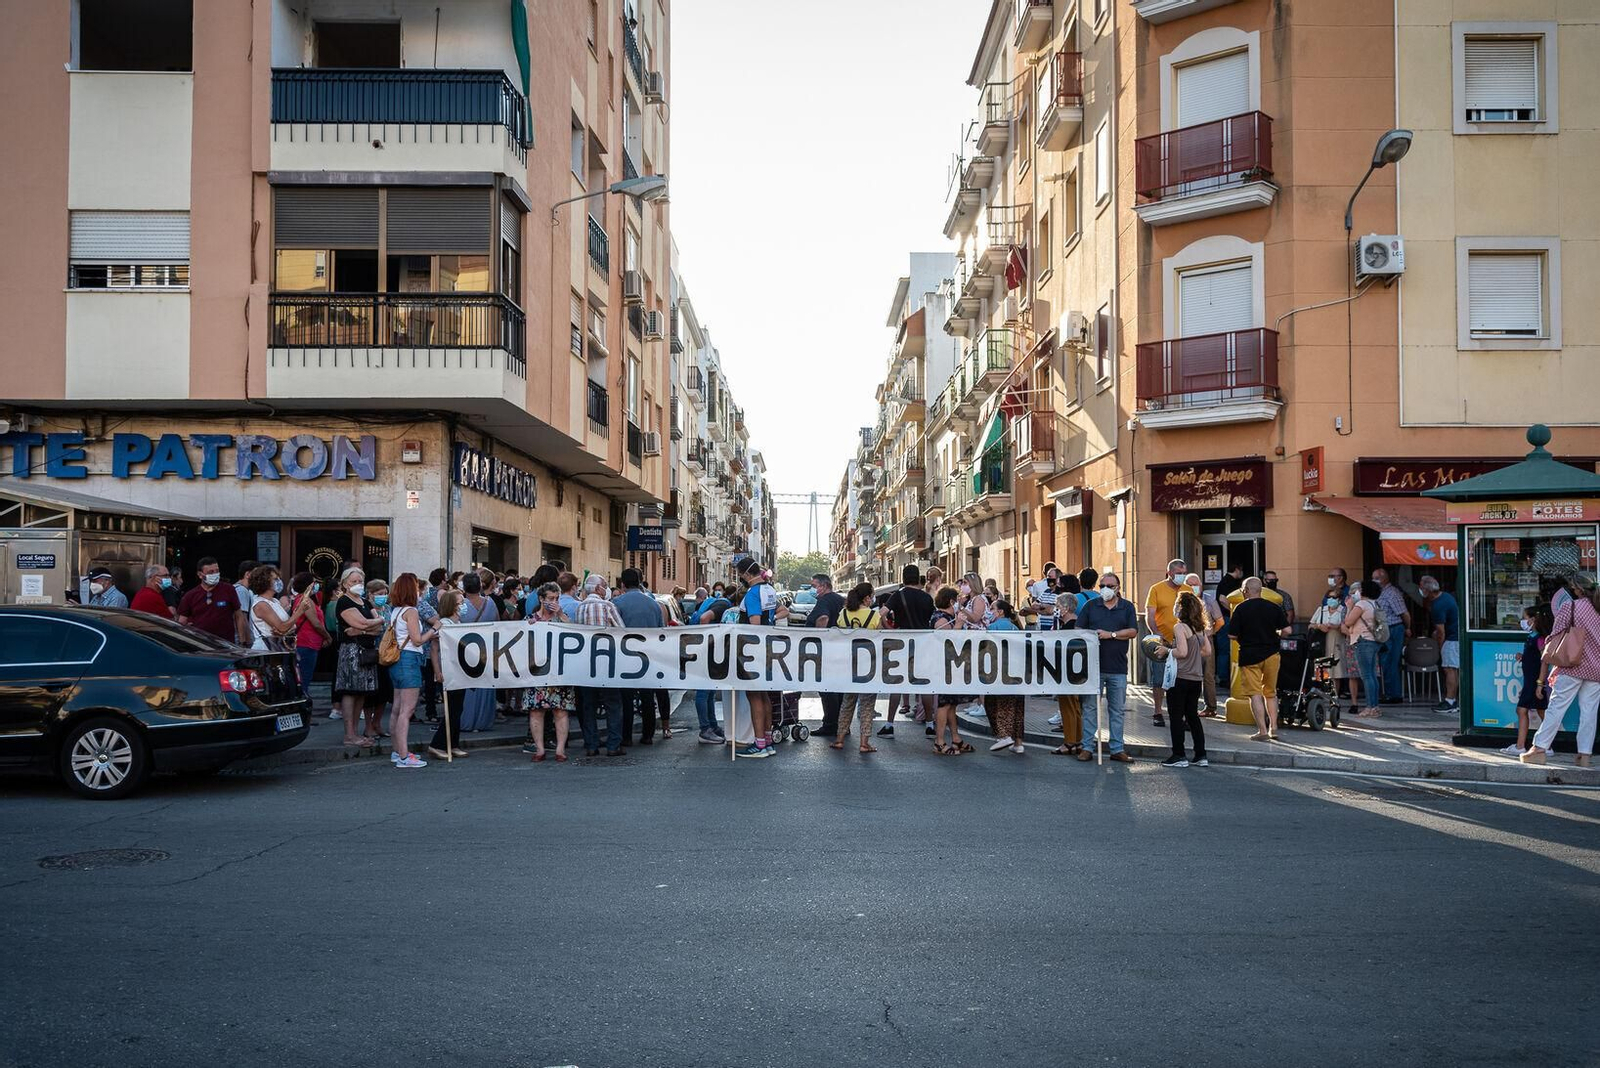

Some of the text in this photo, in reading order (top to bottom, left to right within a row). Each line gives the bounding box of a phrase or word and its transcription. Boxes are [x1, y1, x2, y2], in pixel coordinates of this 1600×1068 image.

[0, 432, 376, 481] TE PATRON
[453, 442, 538, 509] BAR PATRON
[1164, 467, 1253, 486] Salón de Juego
[1379, 466, 1426, 488] Las
[1487, 504, 1508, 512] EURO
[1532, 505, 1583, 514] POTES
[639, 527, 662, 536] Dentista
[34, 554, 54, 562] Seguro
[1440, 545, 1458, 560] lu
[678, 633, 823, 683] FUERA
[851, 637, 931, 685] DEL
